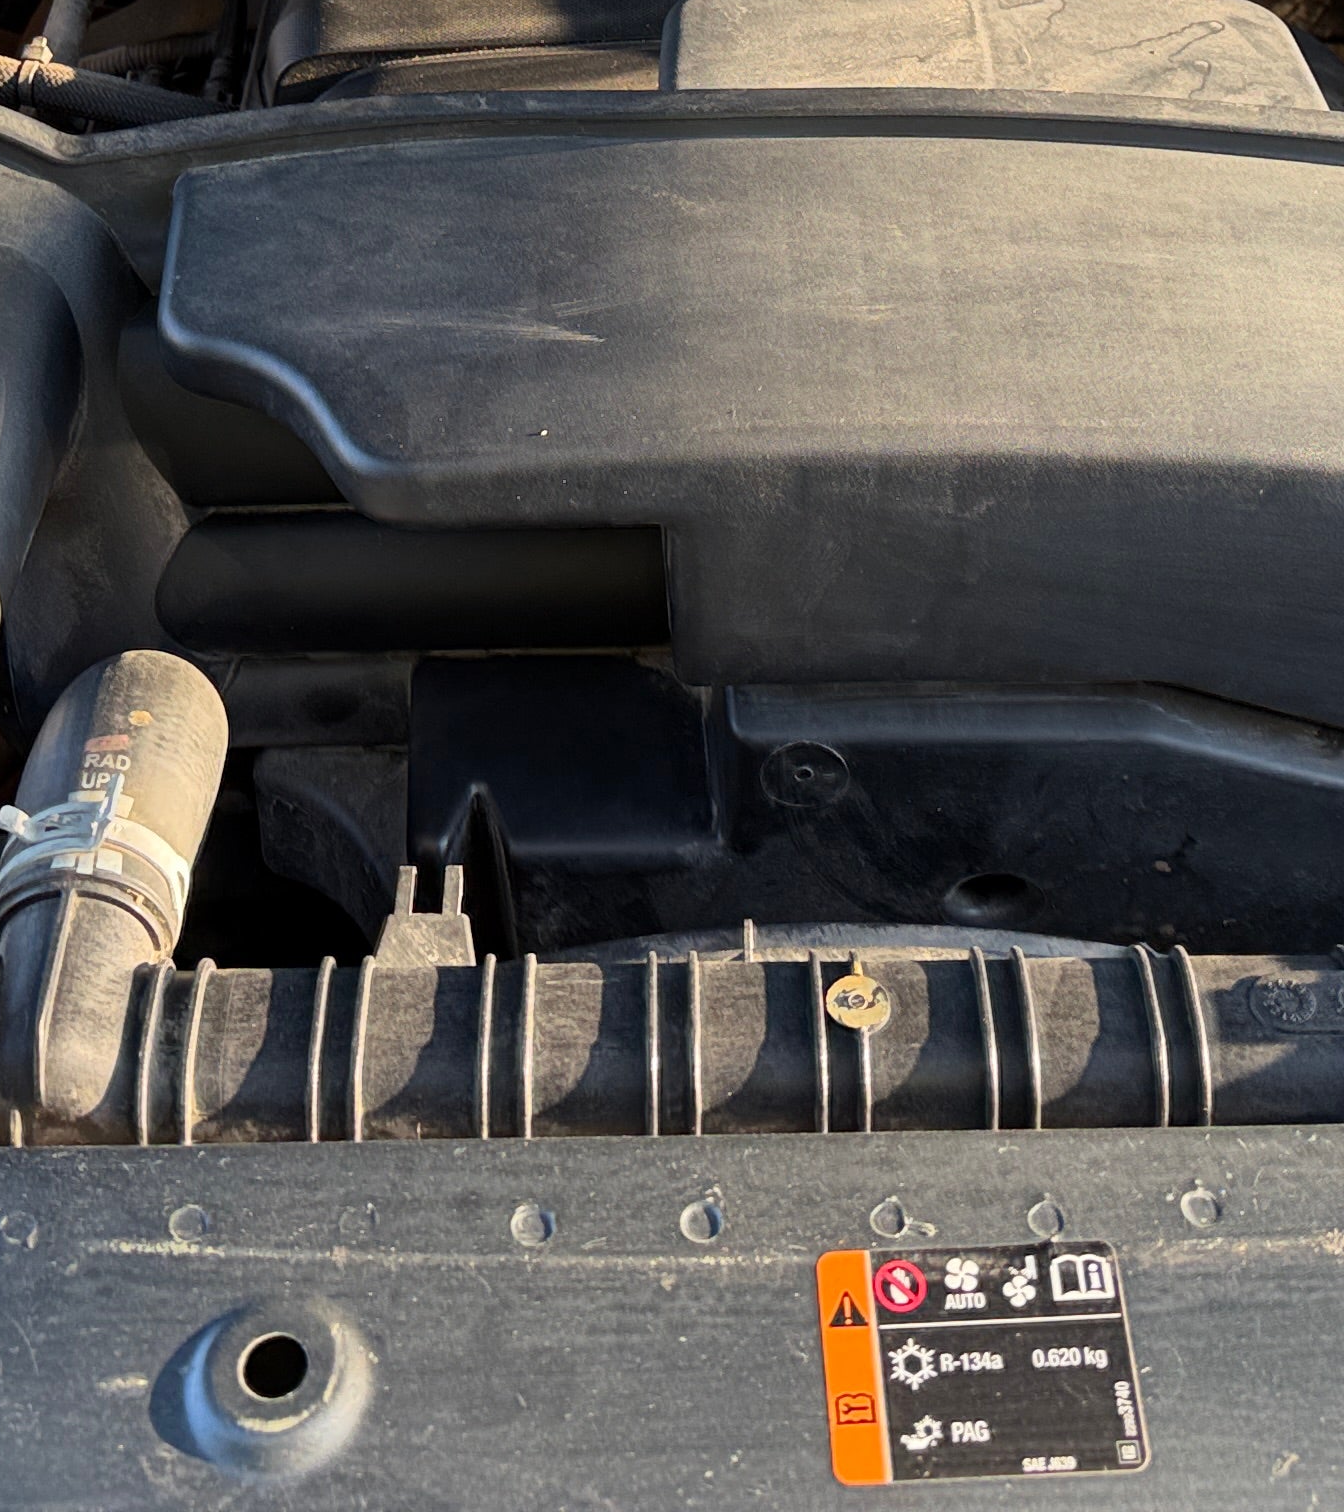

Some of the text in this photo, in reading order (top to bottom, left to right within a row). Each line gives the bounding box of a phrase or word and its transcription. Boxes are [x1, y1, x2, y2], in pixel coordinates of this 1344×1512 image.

[84, 753, 132, 772] RAD
[81, 770, 125, 790] UP
[945, 1293, 986, 1309] AUTO
[940, 1346, 1108, 1371] R-134a 0.620 kg
[951, 1420, 991, 1443] PAG
